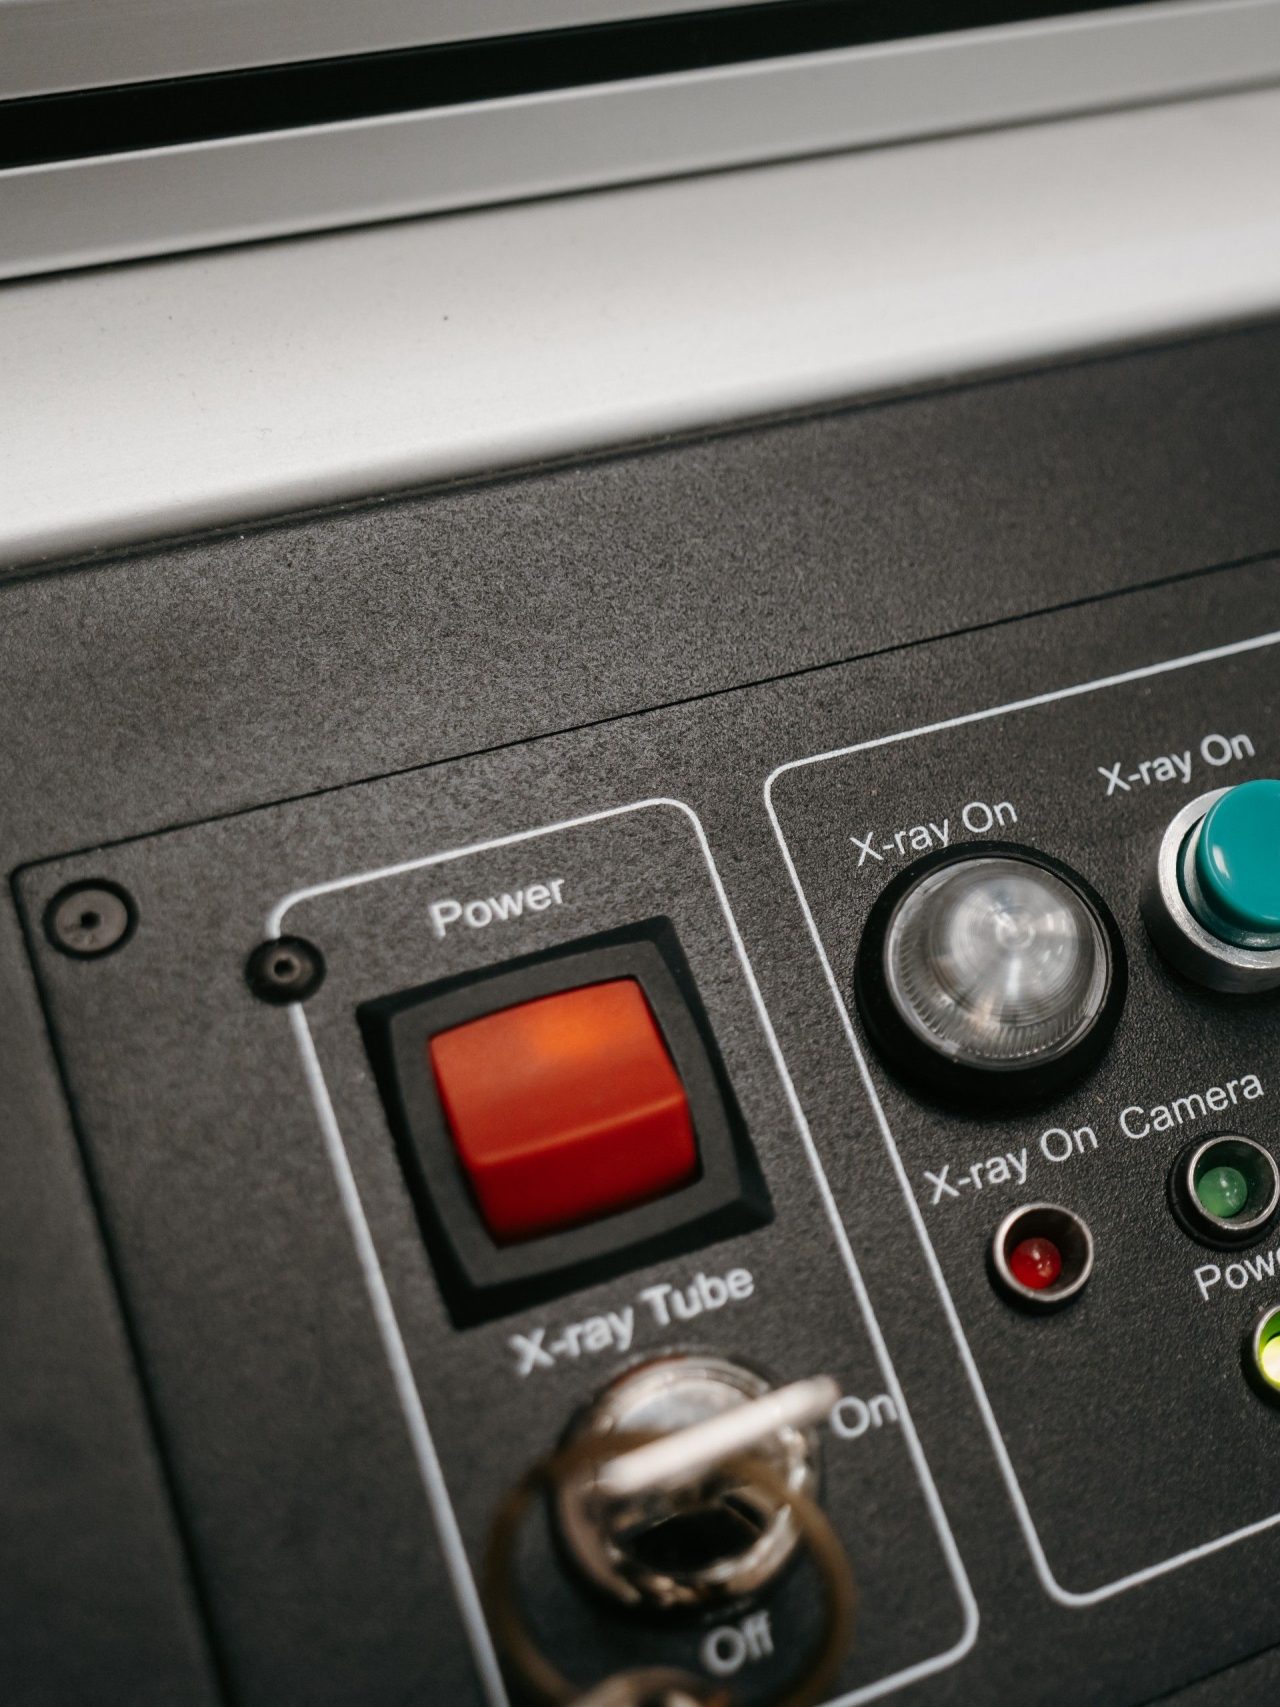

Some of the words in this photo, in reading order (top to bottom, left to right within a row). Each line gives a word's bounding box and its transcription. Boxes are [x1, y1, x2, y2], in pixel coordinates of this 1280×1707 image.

[1098, 750, 1192, 796] X-ray
[1200, 732, 1256, 767] On
[850, 818, 950, 867] X-ray
[961, 799, 1019, 834] On
[430, 878, 566, 938] Power
[1119, 1074, 1264, 1140] Camera
[924, 1148, 1029, 1205] X-ray
[1040, 1124, 1098, 1162] On
[509, 1307, 634, 1378] X-ray
[640, 1267, 754, 1326] Tube
[829, 1392, 899, 1440] On
[704, 1610, 775, 1676] Off
